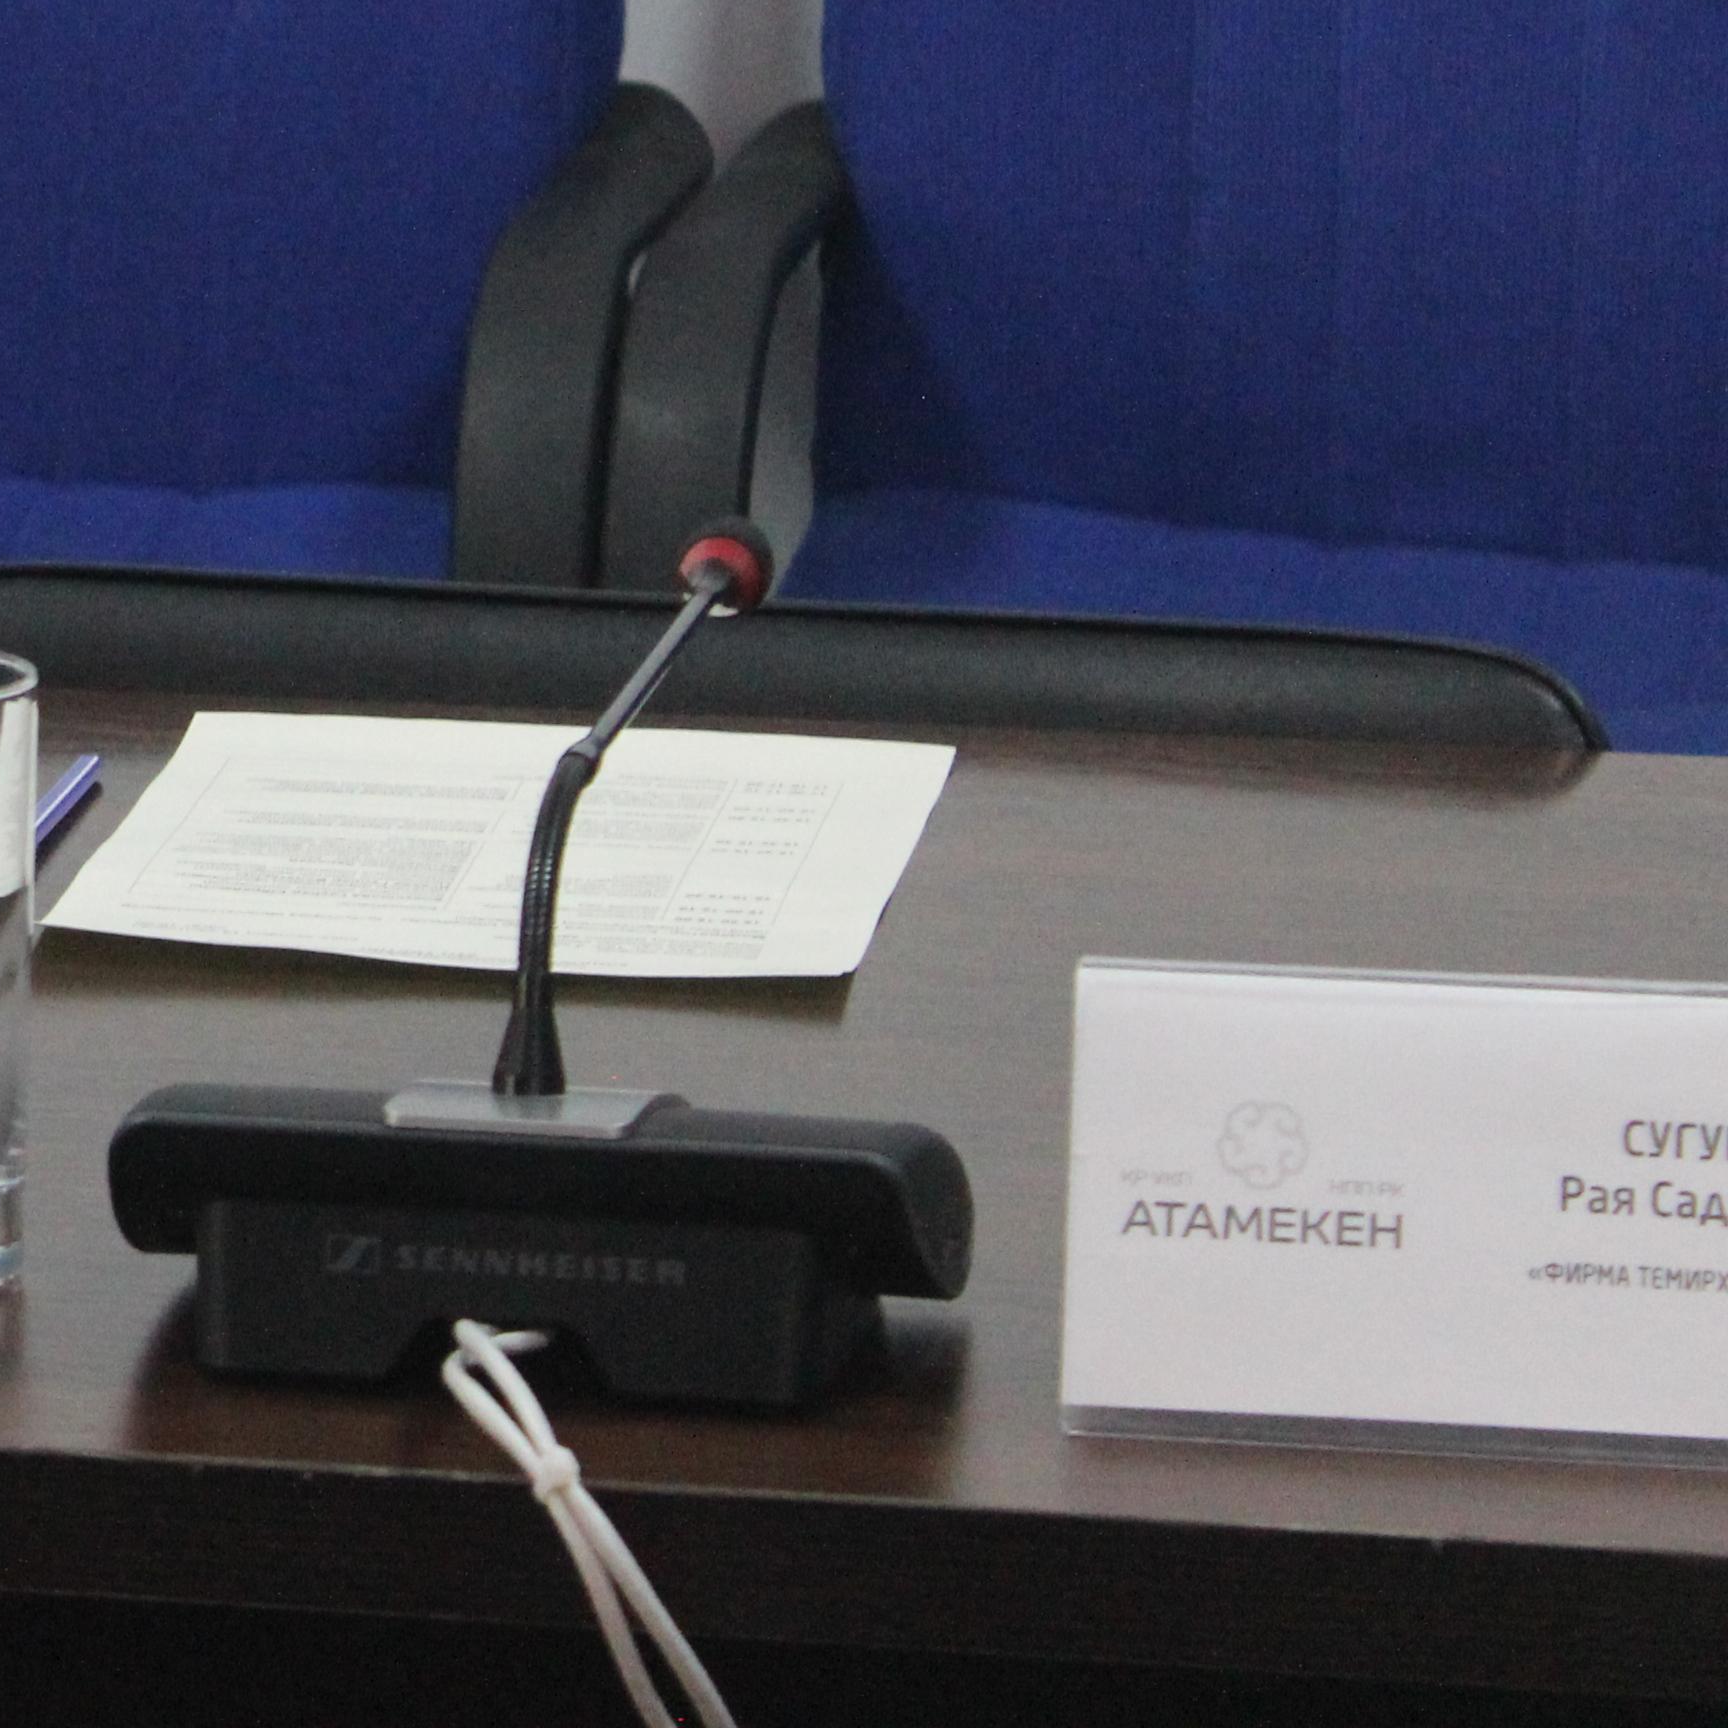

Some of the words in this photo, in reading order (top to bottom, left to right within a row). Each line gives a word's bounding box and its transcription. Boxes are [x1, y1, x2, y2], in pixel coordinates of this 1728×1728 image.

[1623, 1120, 1728, 1161] СУГУ
[1560, 1175, 1635, 1215] Рая
[1121, 1200, 1404, 1249] АТАМЕКЕН
[396, 1244, 687, 1286] SENNHEISER
